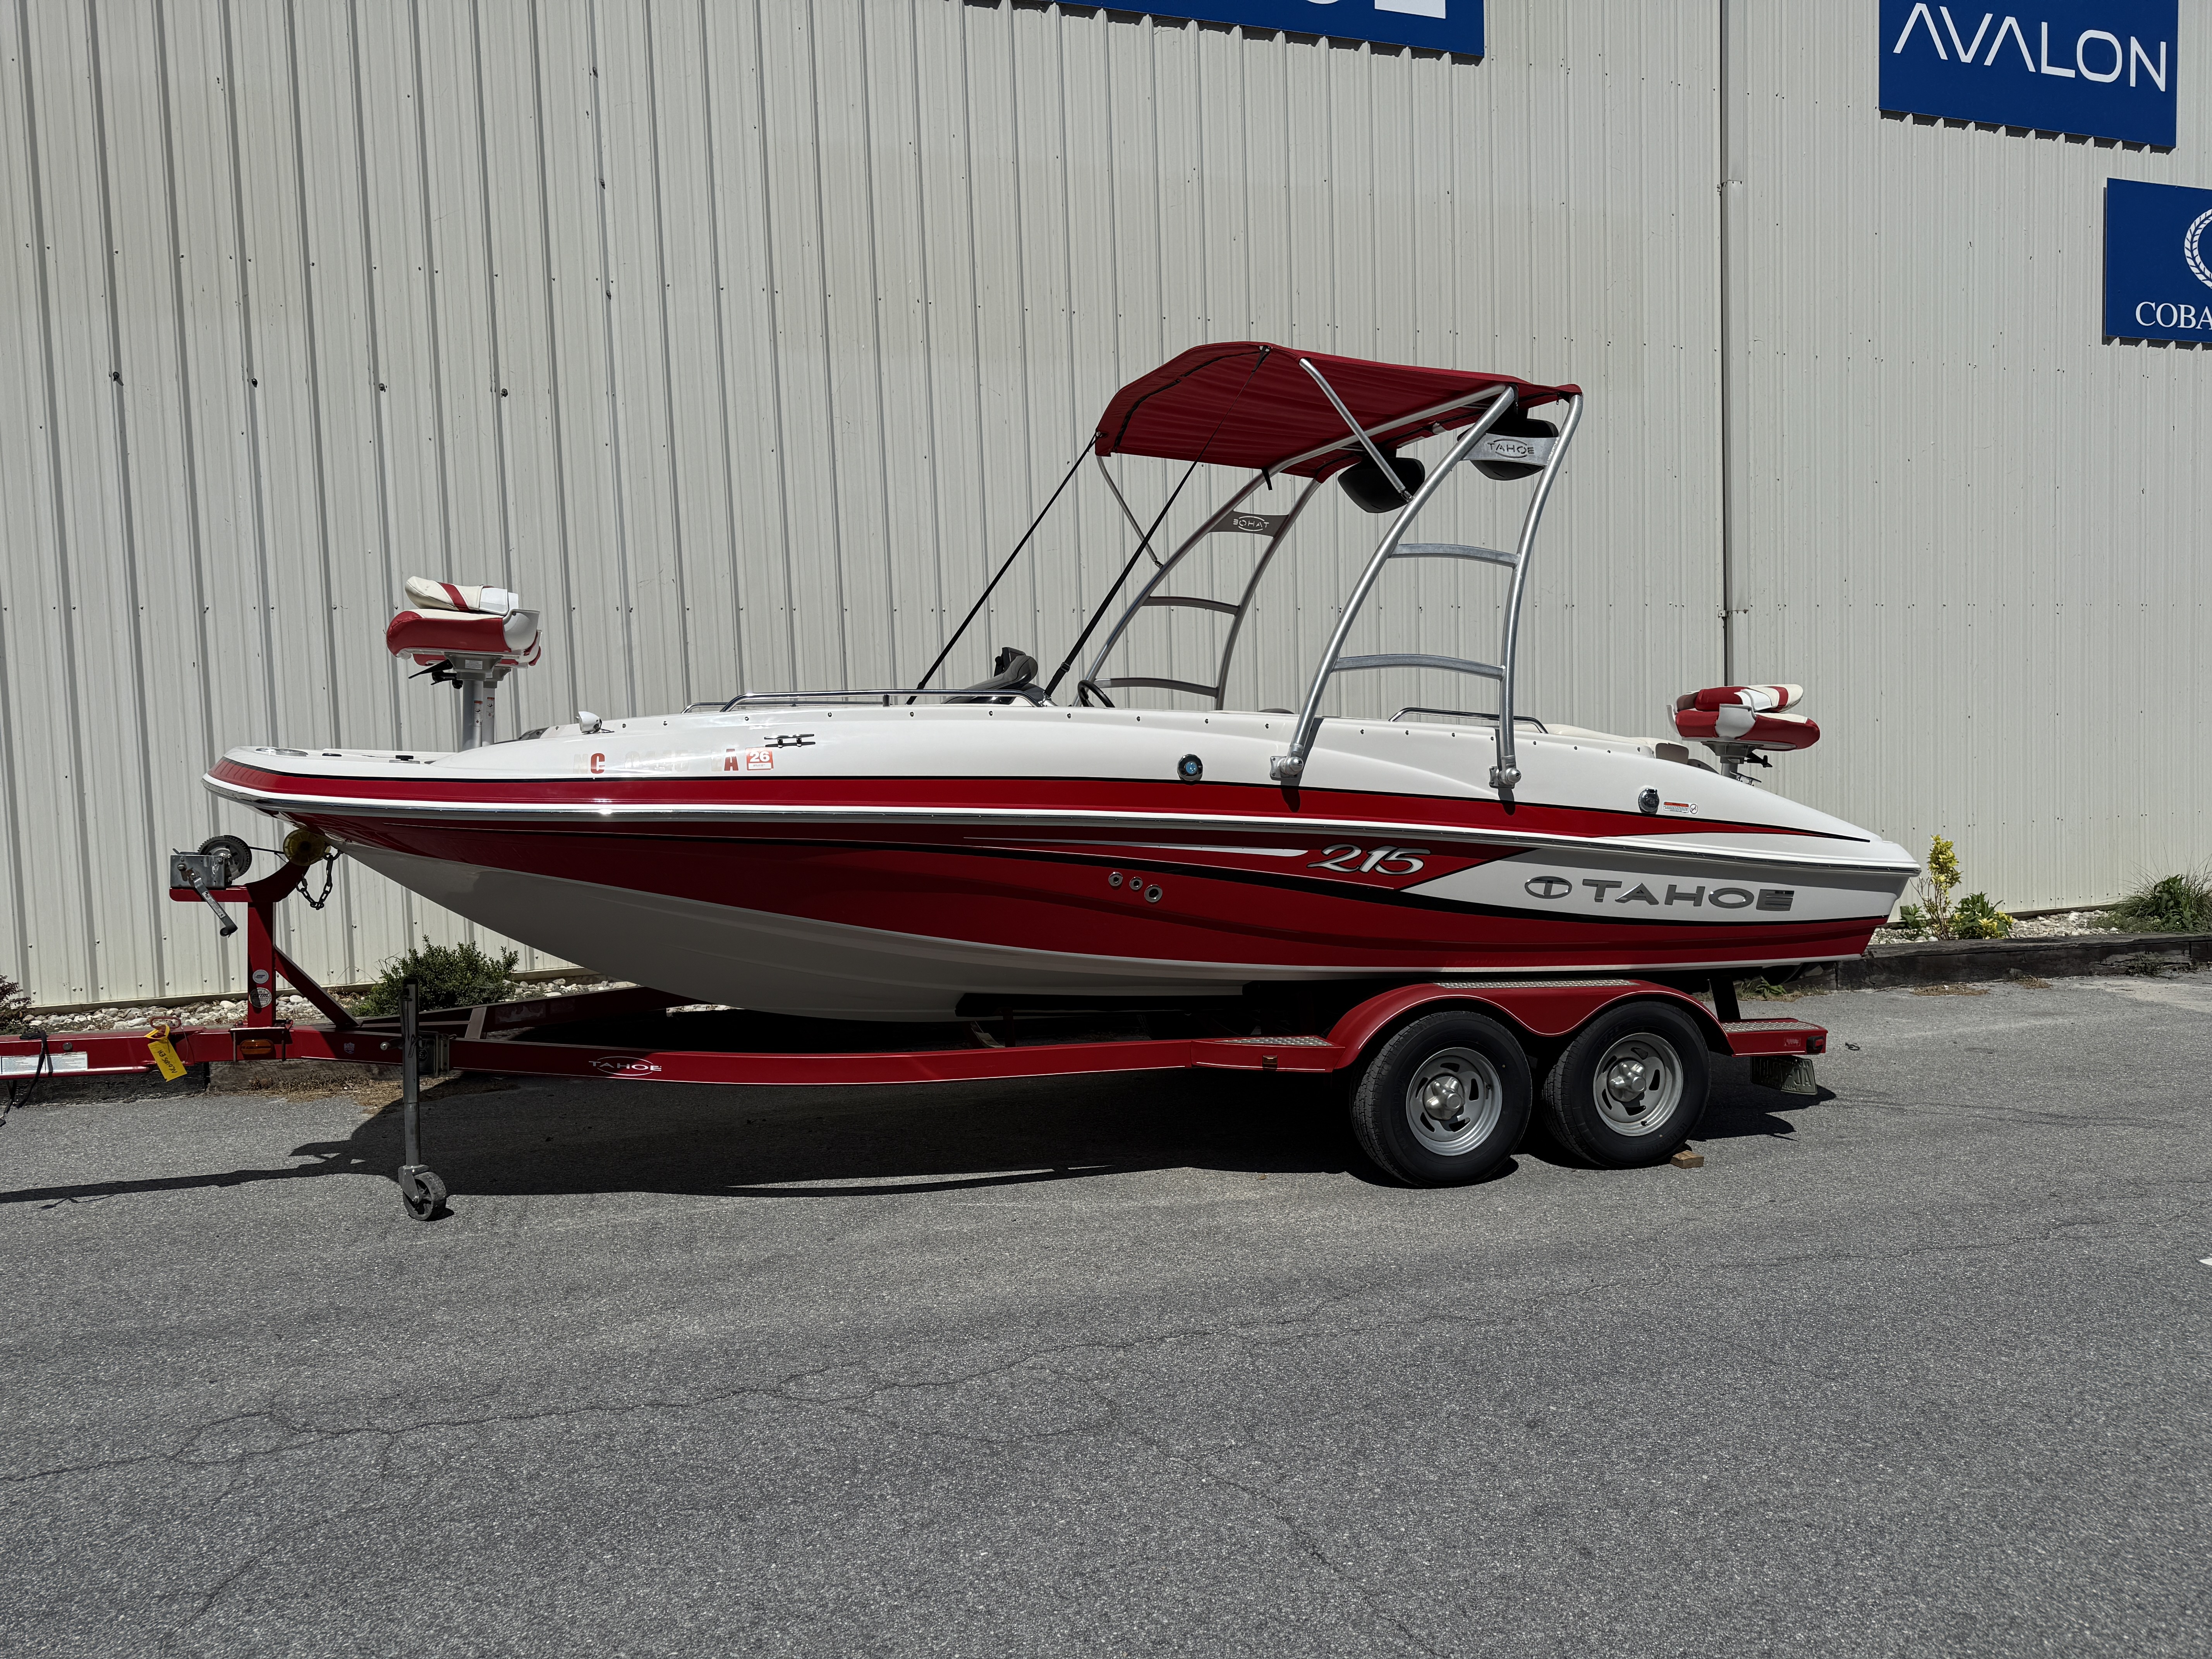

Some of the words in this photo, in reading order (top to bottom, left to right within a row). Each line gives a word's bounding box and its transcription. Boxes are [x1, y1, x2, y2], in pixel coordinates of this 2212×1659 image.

[1893, 2, 2166, 92] AVALON
[2135, 301, 2212, 330] COBA
[1487, 442, 1534, 454] TAHOE
[749, 750, 770, 762] 26
[1307, 843, 1431, 875] 215
[1582, 878, 1795, 911] TAHOE
[589, 1061, 662, 1072] TAHOE
